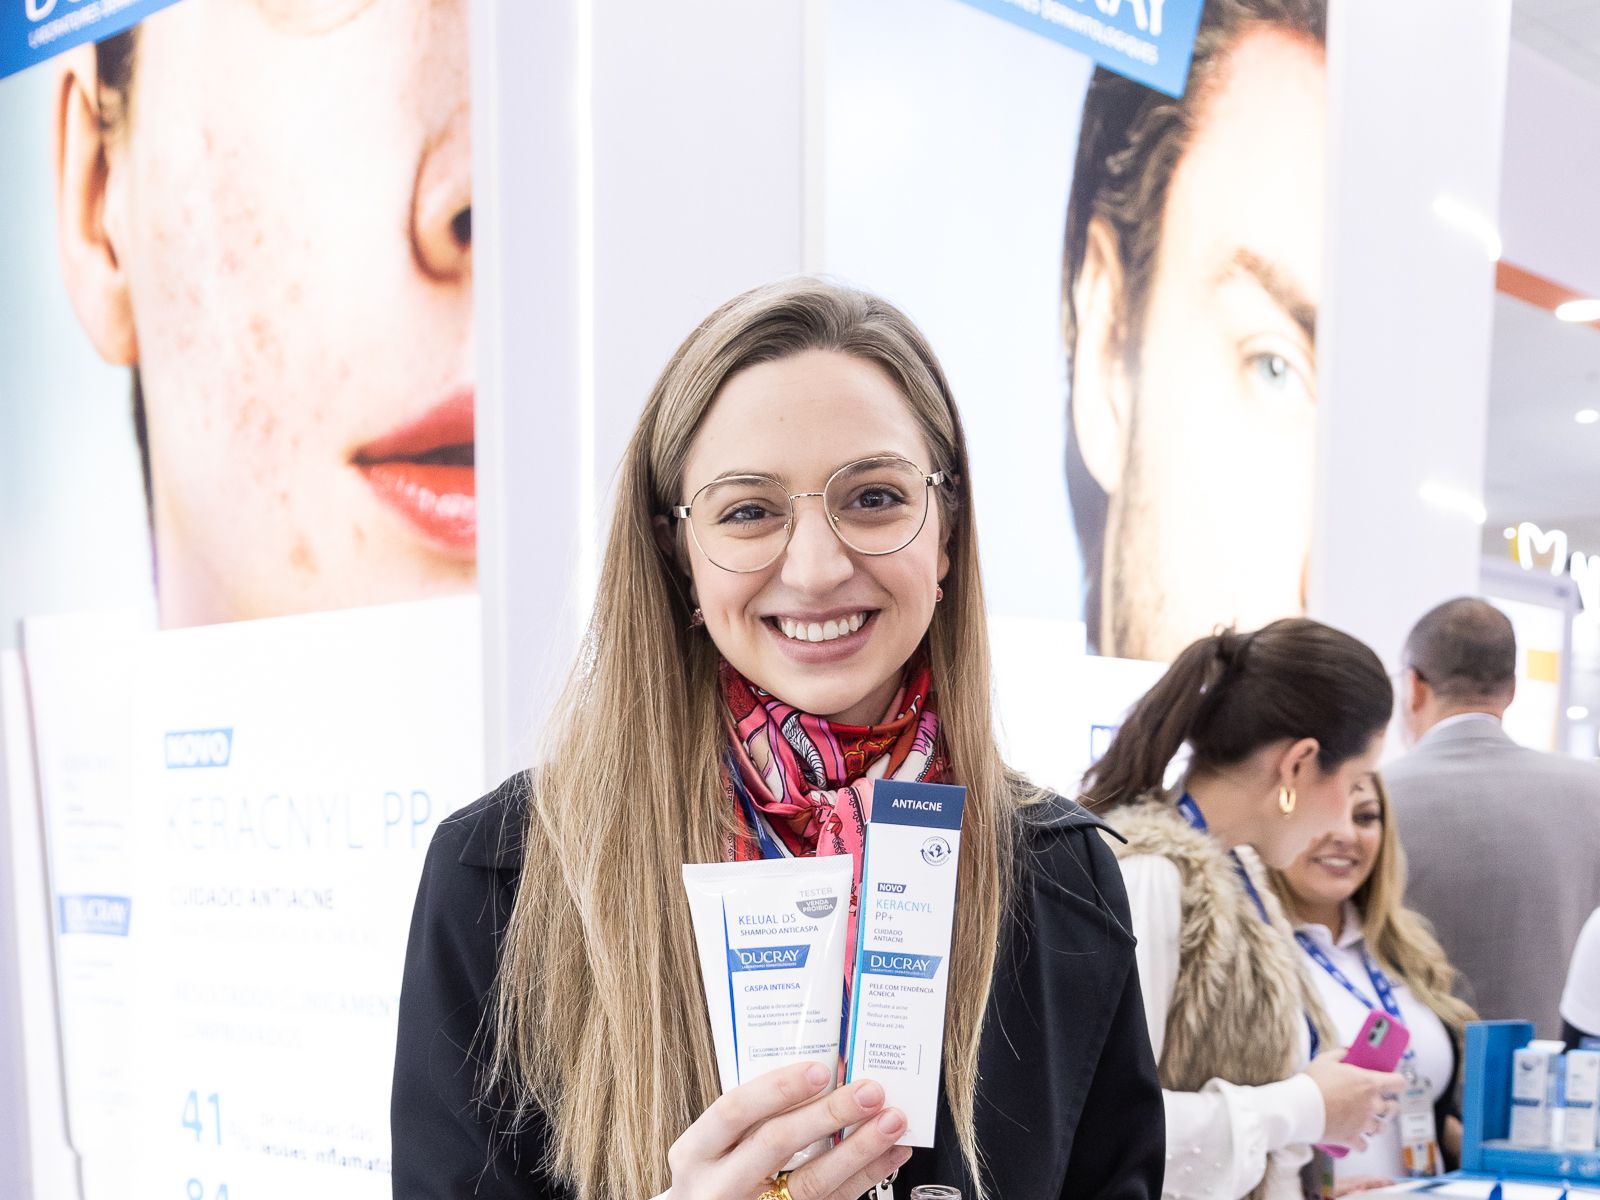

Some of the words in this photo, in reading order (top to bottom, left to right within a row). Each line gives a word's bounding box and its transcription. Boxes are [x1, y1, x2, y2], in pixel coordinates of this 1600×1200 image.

[892, 798, 943, 811] ANTIACNE
[165, 792, 364, 850] KERACNYL
[800, 887, 833, 898] TESTER
[879, 884, 903, 892] NOVO
[802, 903, 834, 913] PROIBIDA
[806, 899, 830, 907] VENDA
[876, 898, 933, 913] KERACNYL
[738, 914, 779, 925] KELUAL
[782, 913, 797, 923] DS
[875, 911, 895, 921] PP+
[740, 928, 777, 936] SHAMPOO
[779, 925, 819, 934] ANTICASPA
[873, 928, 903, 936] CUIDADO
[873, 935, 904, 943] ANTIACNE
[741, 949, 799, 965] DUCRAY
[870, 954, 931, 971] DUCRAY
[744, 984, 769, 993] CASPA
[769, 982, 801, 991] INTENSA
[900, 985, 935, 994] TENDÊNCIA
[868, 990, 895, 998] ACNEICA
[868, 1058, 896, 1066] VITAMINA
[181, 1089, 222, 1146] 41
